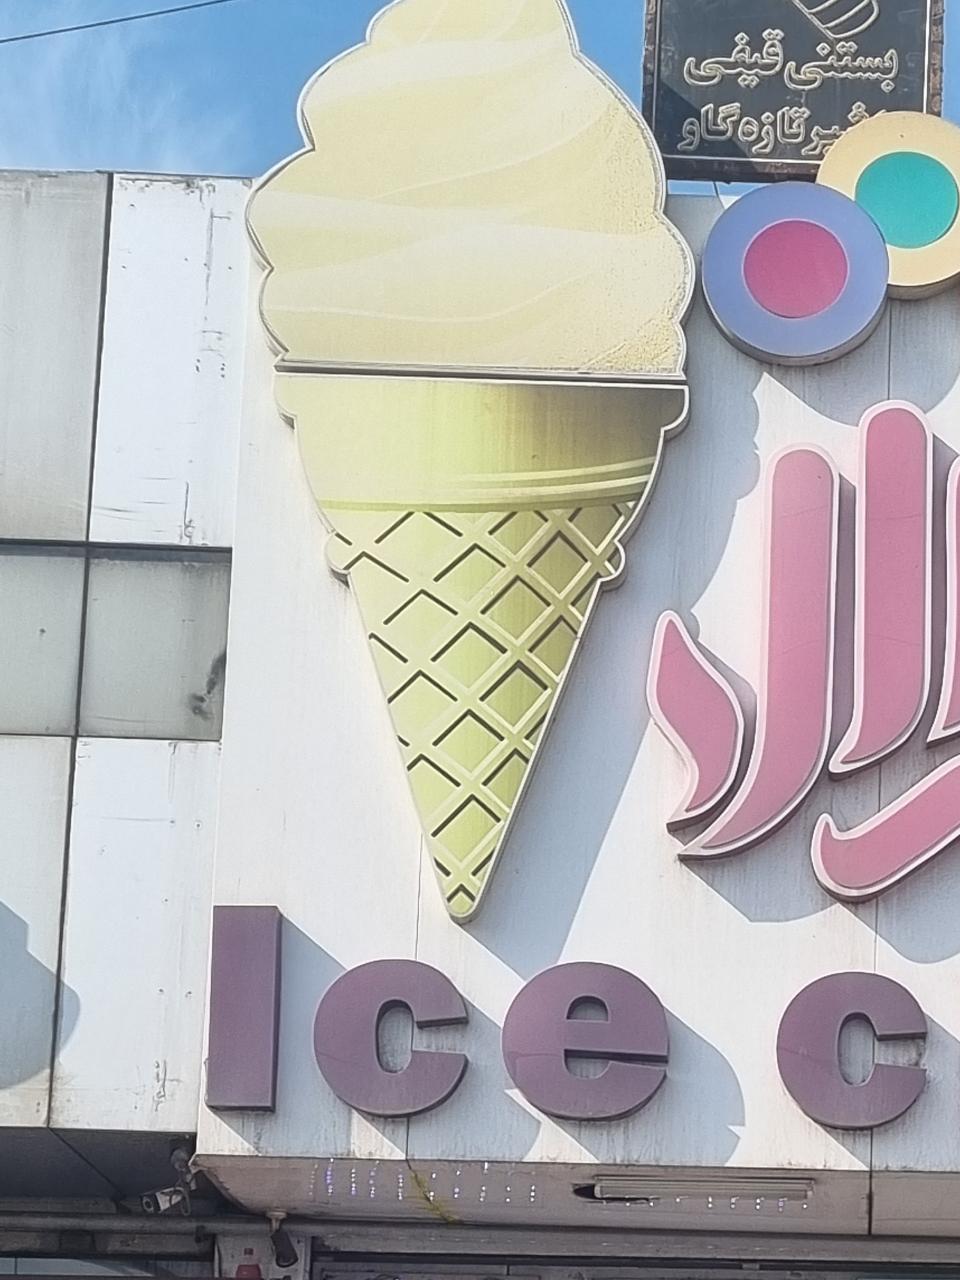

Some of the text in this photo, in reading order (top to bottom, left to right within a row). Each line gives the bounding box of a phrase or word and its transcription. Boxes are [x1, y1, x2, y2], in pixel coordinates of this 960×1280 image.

[684, 28, 898, 93] بستنی قیفی
[205, 905, 669, 1121] Ice
